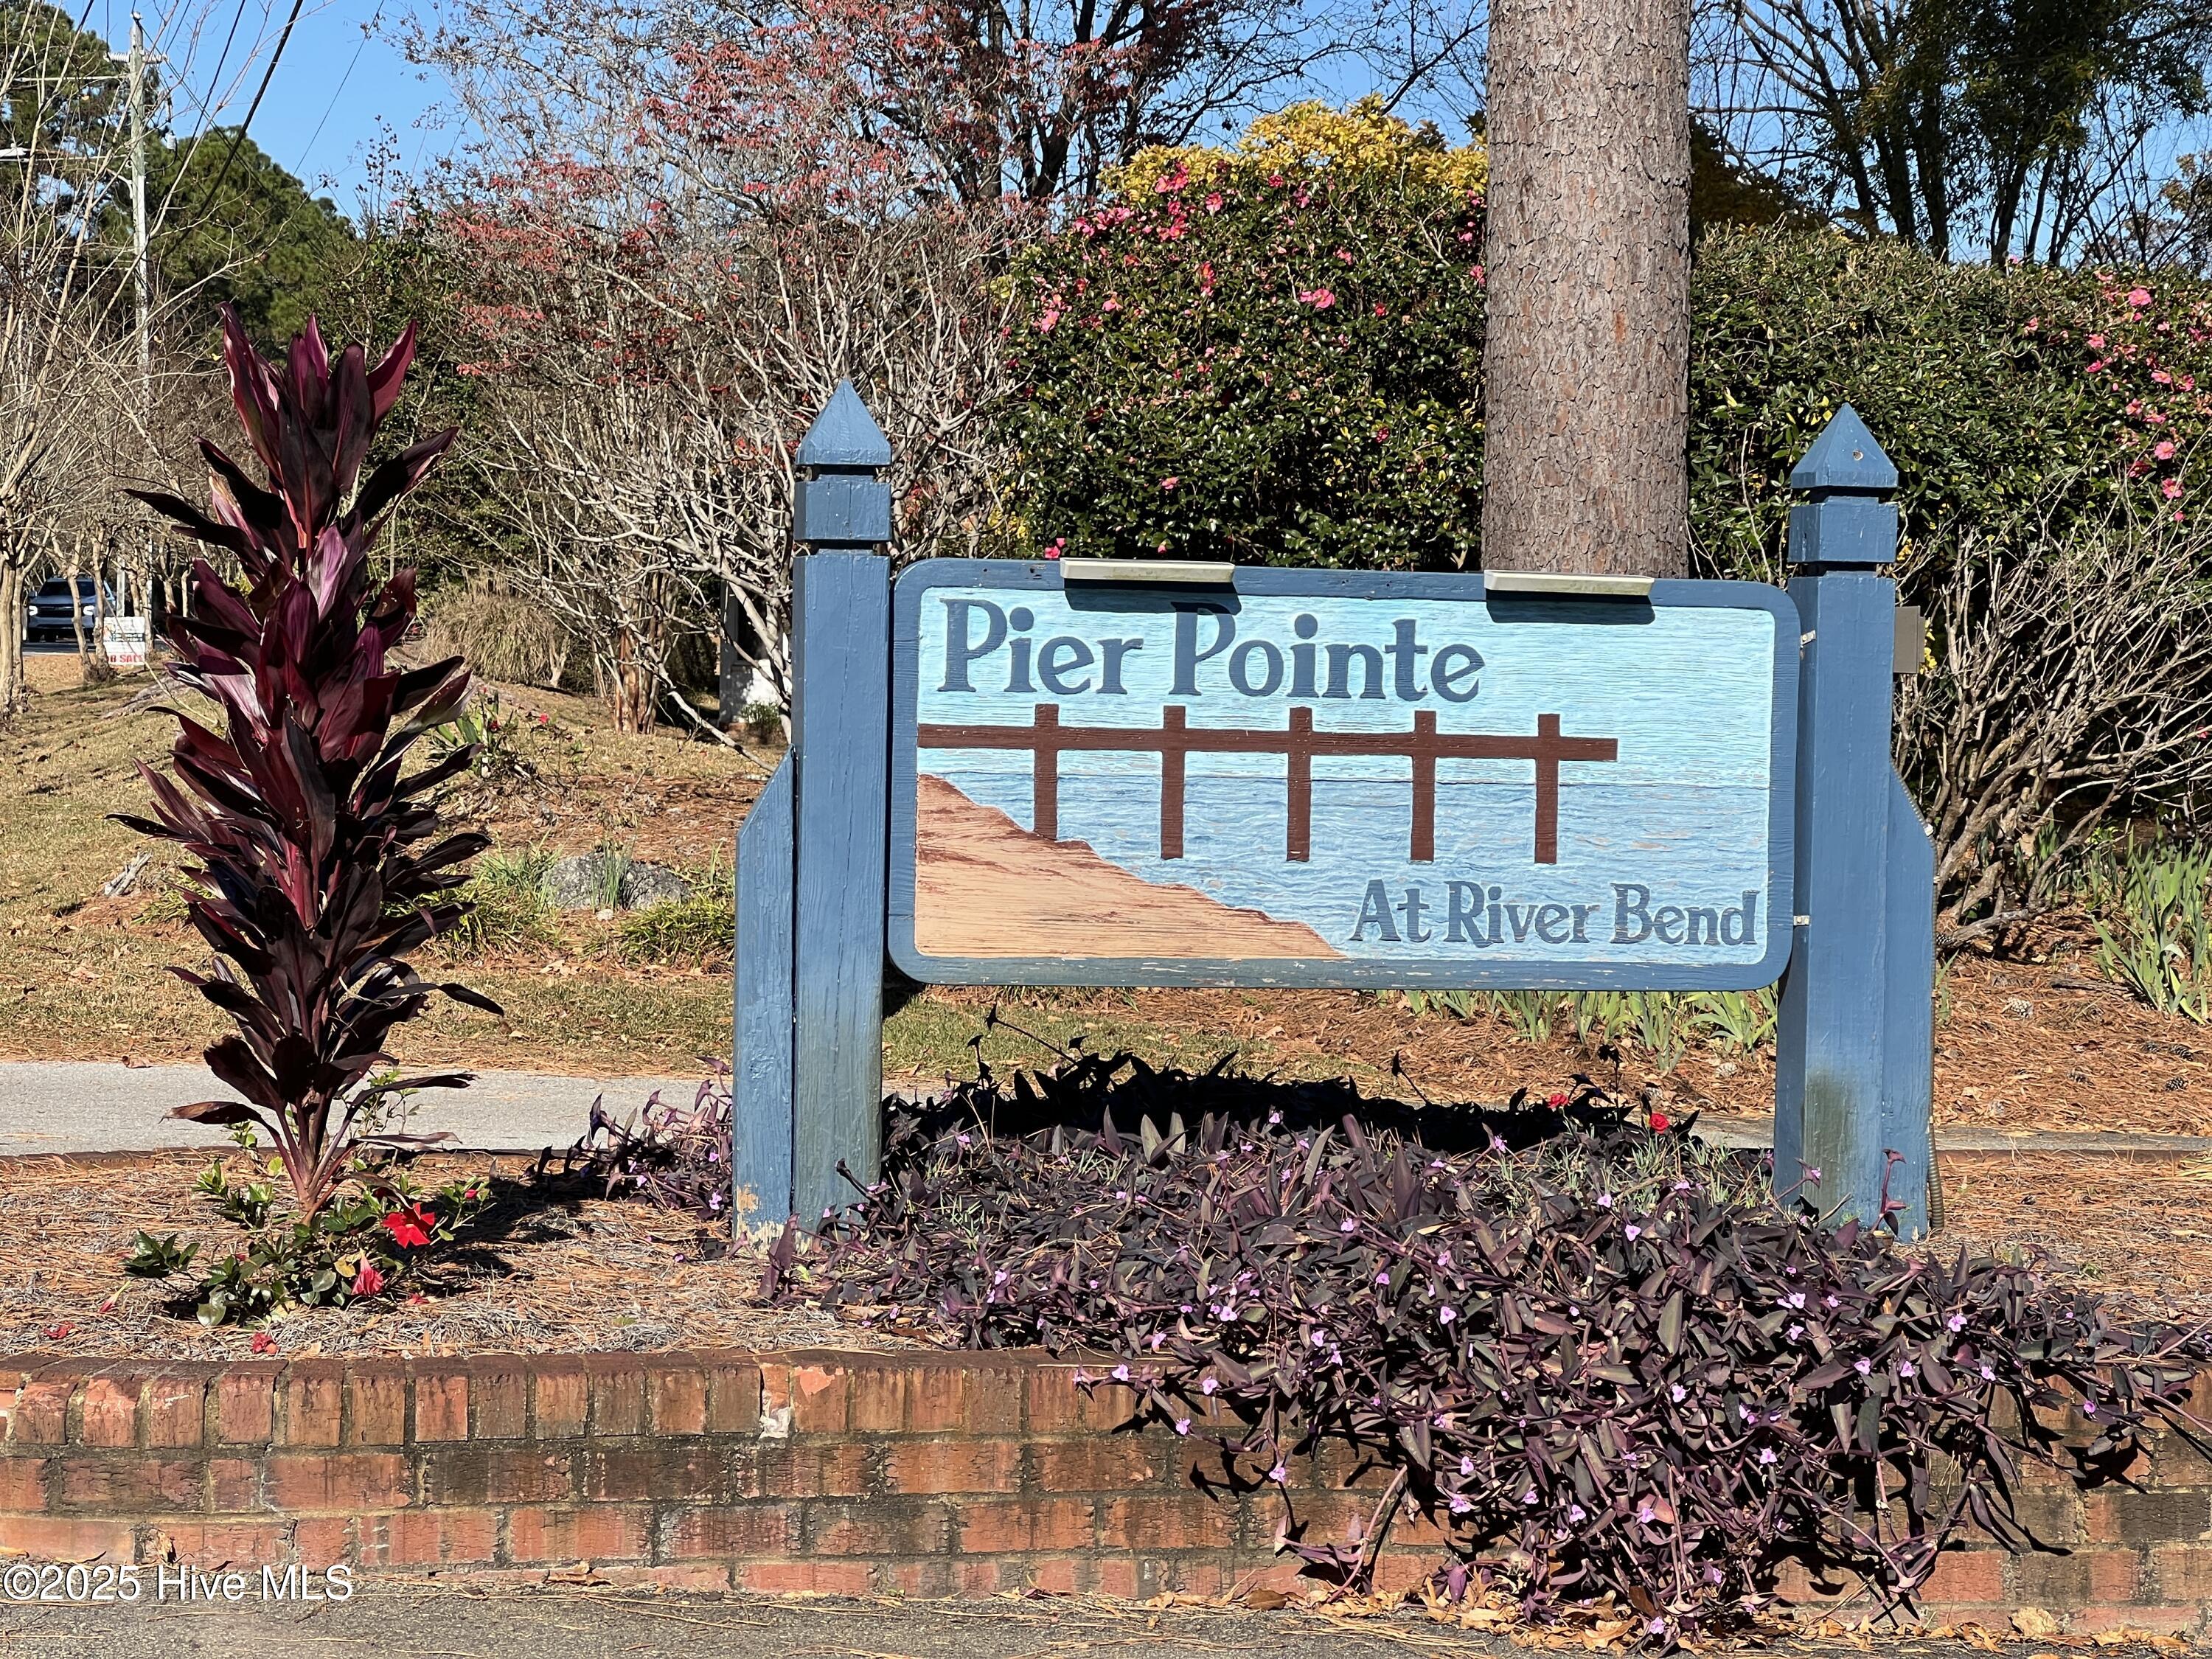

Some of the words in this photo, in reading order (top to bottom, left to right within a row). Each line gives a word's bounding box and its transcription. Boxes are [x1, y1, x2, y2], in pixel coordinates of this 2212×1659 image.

[937, 597, 1144, 695] Pier
[1169, 601, 1486, 703] Pointe
[1349, 879, 1433, 943] At
[1444, 880, 1601, 948] River
[1610, 883, 1761, 946] Bend
